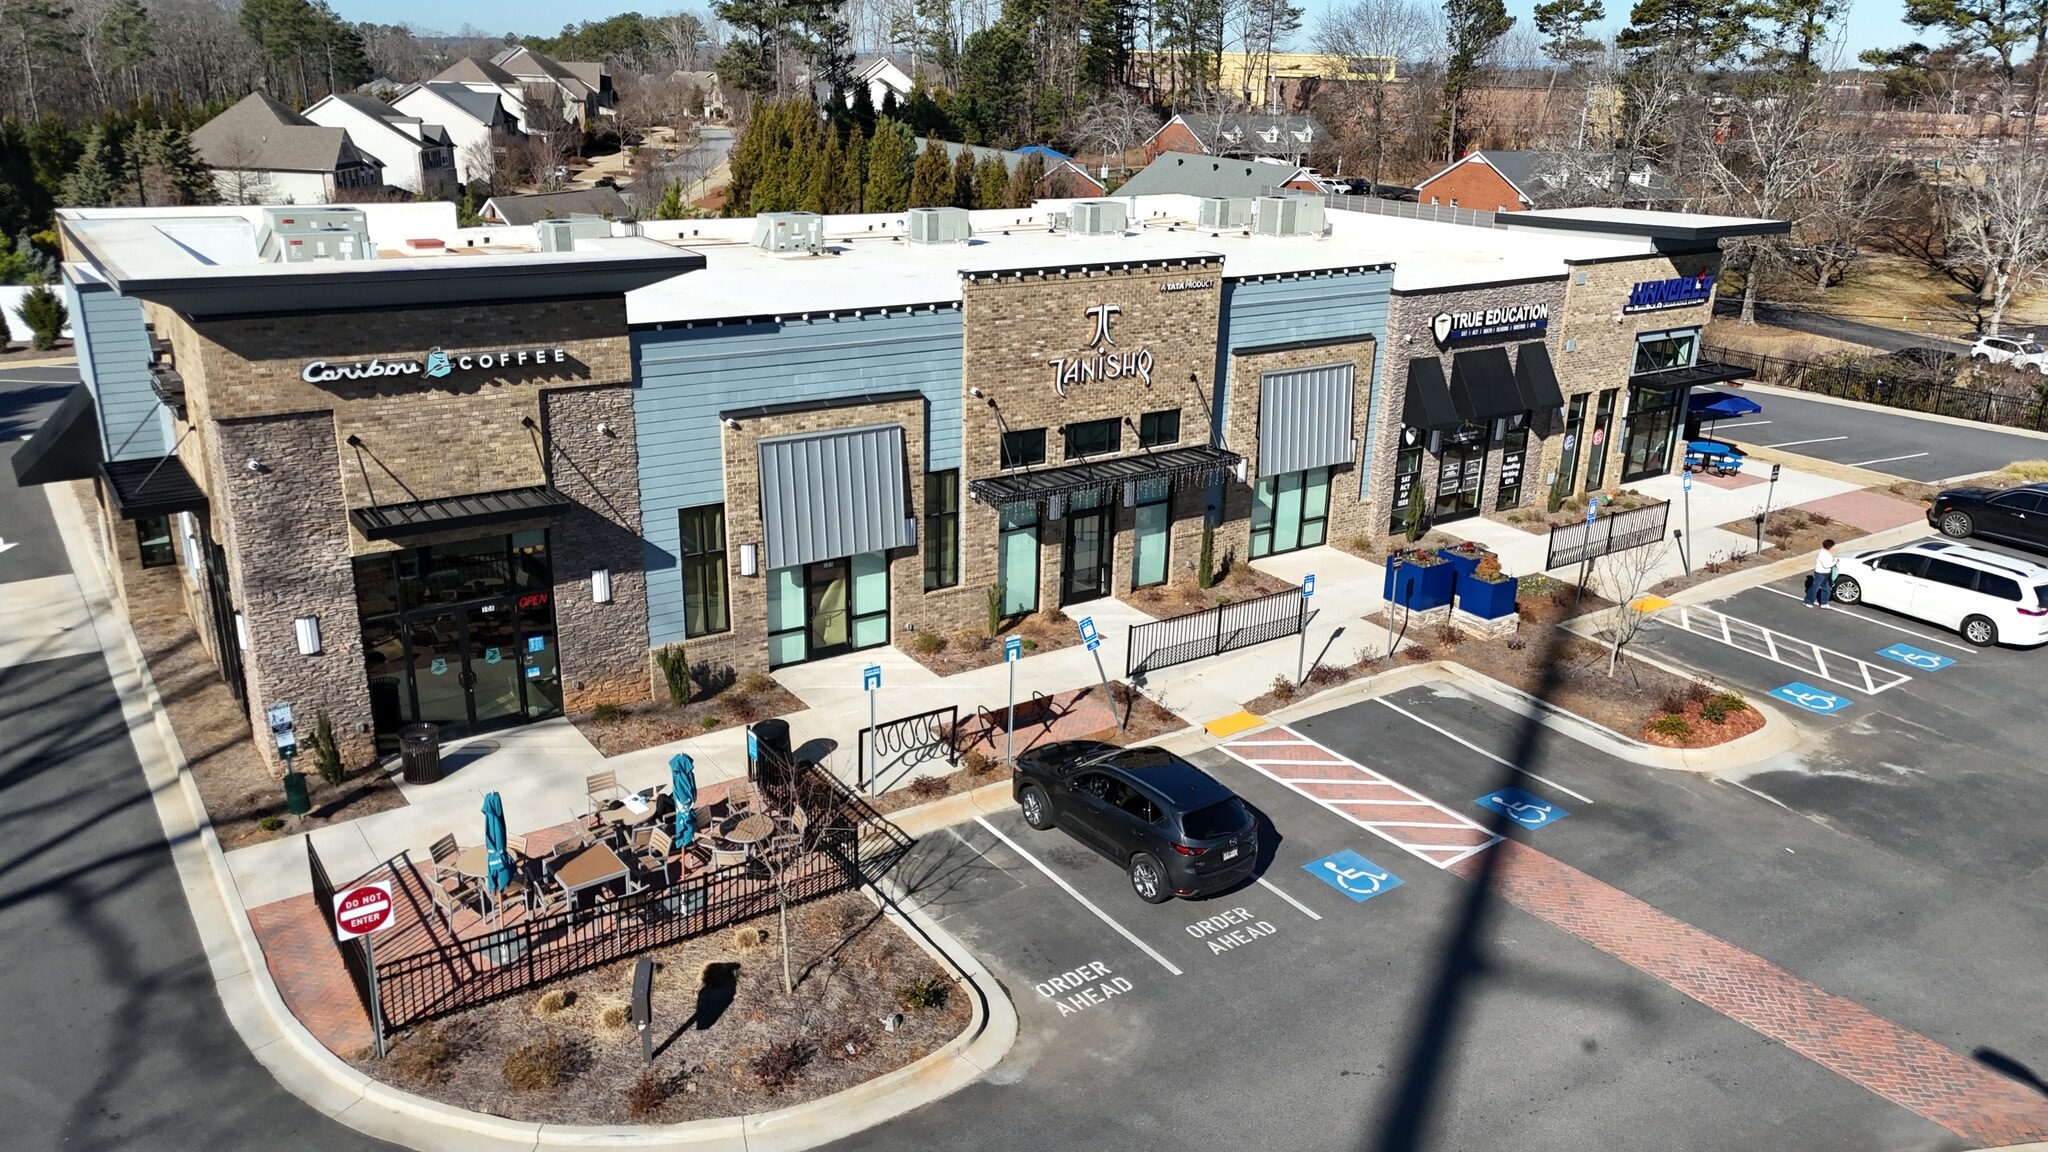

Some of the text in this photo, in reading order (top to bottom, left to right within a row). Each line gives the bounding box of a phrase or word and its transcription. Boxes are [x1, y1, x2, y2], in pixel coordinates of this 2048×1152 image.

[1160, 280, 1214, 291] A TATA PRODUCT
[1452, 303, 1548, 330] TRUE EDUCATION
[302, 349, 565, 383] Caribou COFFEE
[1049, 347, 1154, 398] TANISHQ
[518, 593, 548, 608] OPEN
[345, 892, 382, 910] DO NOT
[350, 913, 380, 928] ENTER
[1185, 907, 1255, 938] ORDER
[1206, 920, 1277, 955] AHEAD
[1035, 961, 1112, 998] ORDER
[1055, 976, 1133, 1018] AHEAD
